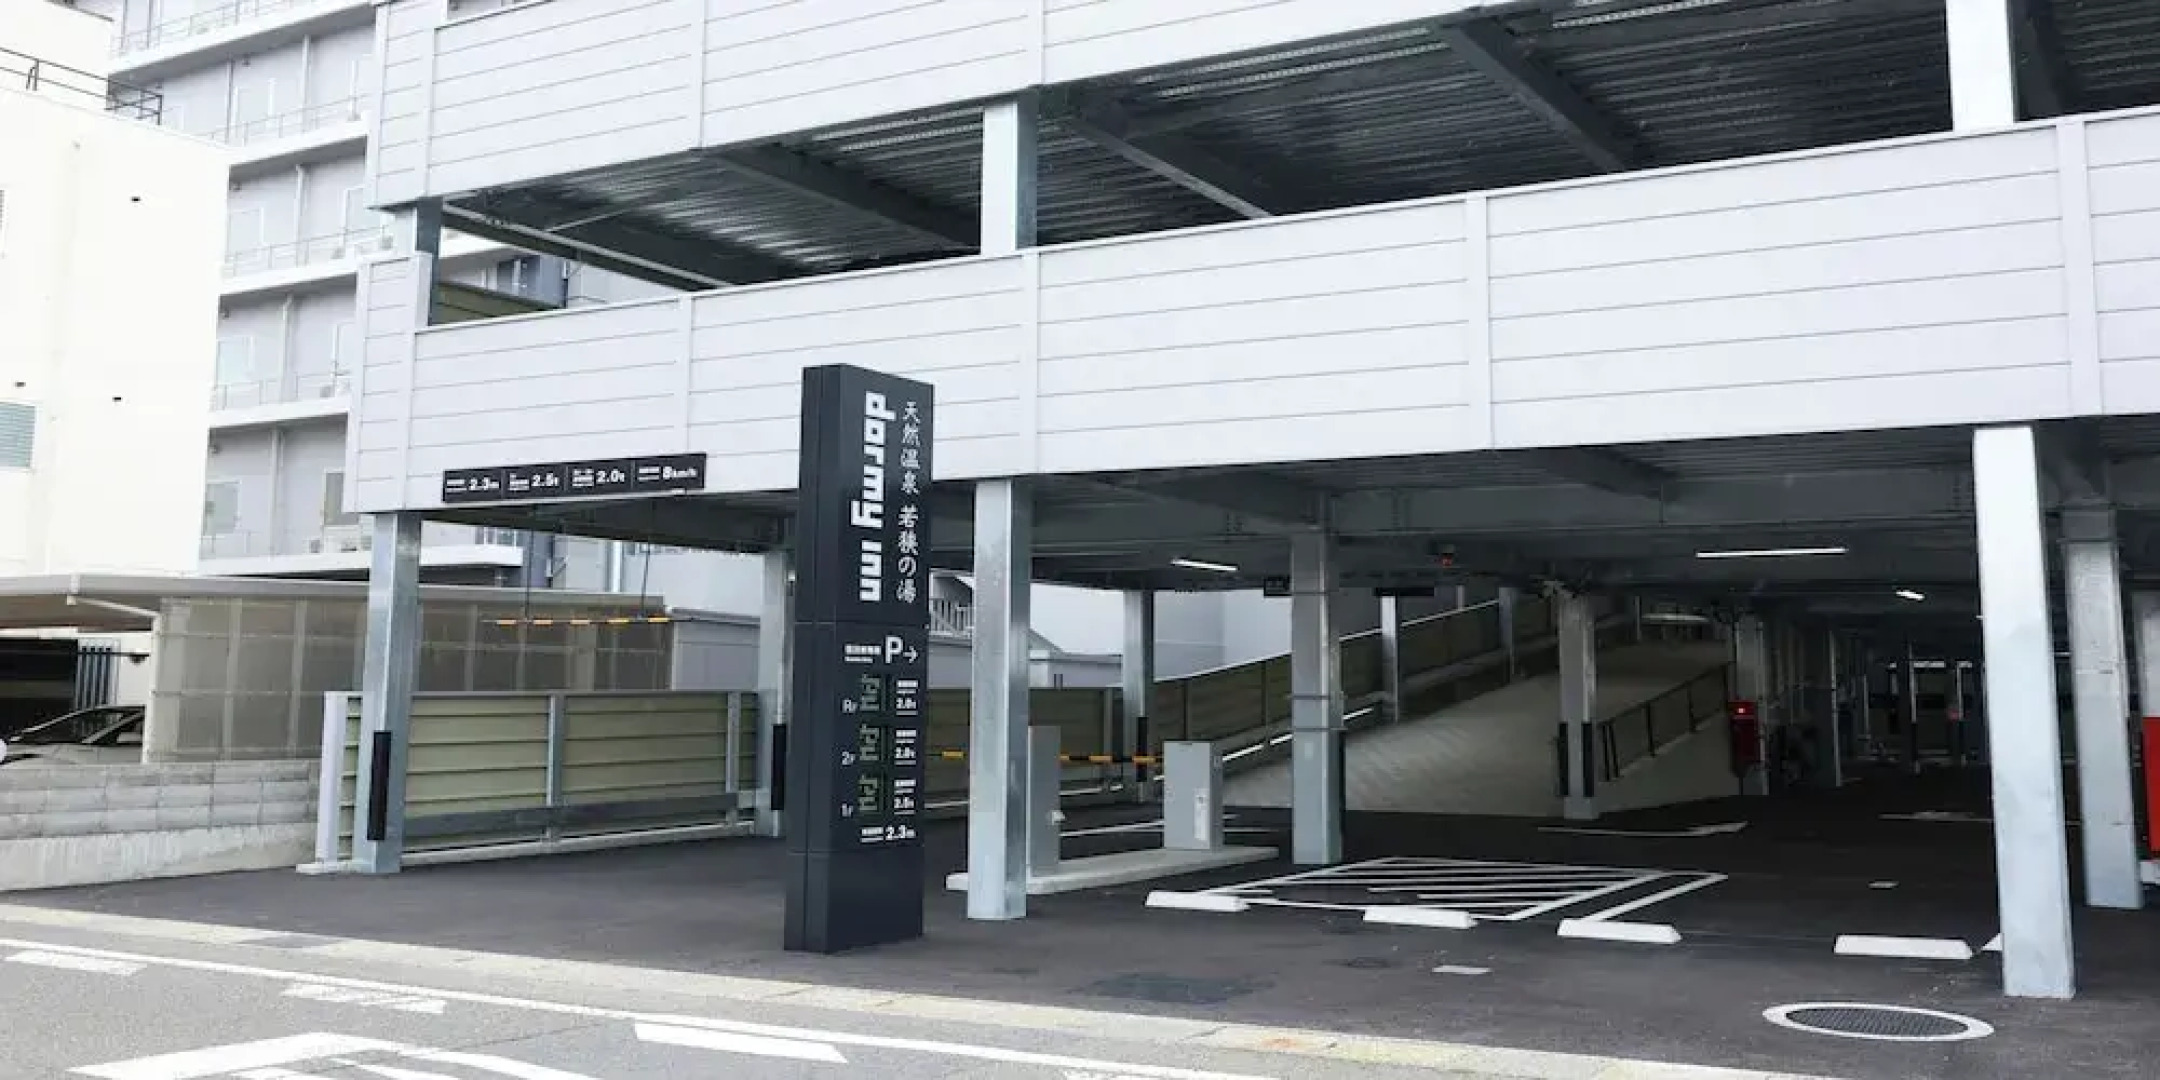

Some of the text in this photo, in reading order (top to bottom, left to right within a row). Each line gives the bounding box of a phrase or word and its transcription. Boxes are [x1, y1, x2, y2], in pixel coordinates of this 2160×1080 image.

[851, 391, 897, 602] dormy inn
[896, 400, 921, 603] 天然温泉 若狭の湯
[885, 635, 903, 664] P
